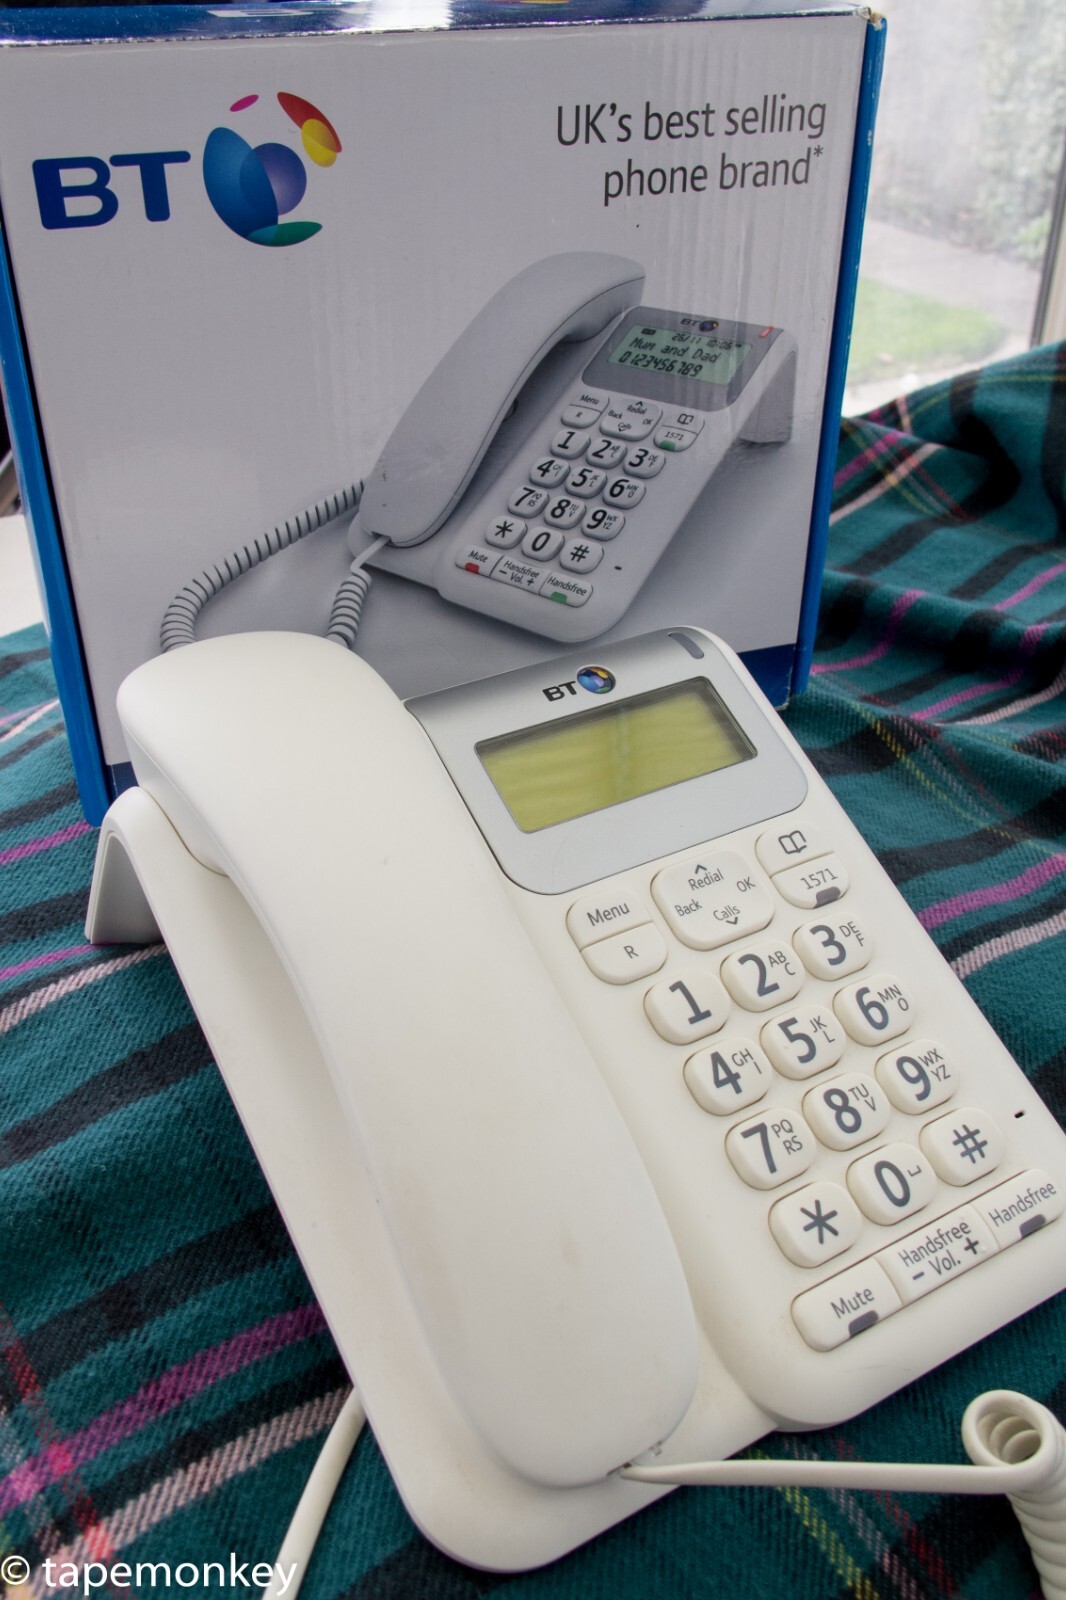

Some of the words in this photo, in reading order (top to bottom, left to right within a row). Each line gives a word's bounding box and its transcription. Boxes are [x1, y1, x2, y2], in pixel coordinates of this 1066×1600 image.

[557, 103, 632, 146] UK’s
[644, 101, 716, 140] best
[724, 93, 827, 139] selling
[32, 150, 192, 230] BT
[604, 158, 708, 207] phone
[629, 337, 656, 351] Mum
[661, 344, 690, 357] and
[692, 348, 722, 363] Dad
[618, 351, 703, 377] 0123456789
[580, 394, 599, 405] Menu
[608, 409, 624, 419] Back
[627, 405, 647, 415] Redial
[618, 422, 632, 430] Calls
[664, 431, 684, 441] 1571
[557, 431, 576, 450] 1
[592, 439, 612, 459] 2
[628, 448, 649, 467] 3
[537, 459, 555, 478] 4
[571, 468, 593, 488] 5
[514, 487, 535, 507] 7
[609, 479, 629, 498] 6
[550, 499, 571, 519] 8
[586, 509, 607, 529] 9
[603, 522, 613, 530] YZ
[531, 532, 551, 552] 0
[468, 550, 488, 563] Mute
[570, 544, 590, 562] #
[504, 560, 540, 579] Handsfree
[510, 572, 523, 584] Vol.
[547, 576, 587, 596] Handsfree
[542, 681, 577, 702] BT
[688, 868, 724, 892] Redial
[736, 876, 756, 893] OK
[801, 868, 838, 891] 1571
[587, 902, 631, 927] Menu
[674, 899, 703, 918] Back
[713, 903, 741, 922] Calls
[838, 921, 860, 938] DE
[809, 924, 847, 966] 3
[855, 933, 866, 947] F
[623, 944, 640, 959] R
[767, 950, 788, 968] AB
[738, 953, 780, 997] 2
[784, 962, 797, 976] C
[669, 980, 712, 1025] 1
[877, 984, 903, 1003] MN
[854, 986, 889, 1031] 6
[809, 1015, 828, 1034] JK
[778, 1016, 817, 1064] 5
[822, 1029, 835, 1043] L
[731, 1047, 754, 1067] GH
[918, 1048, 944, 1068] WX
[710, 1051, 742, 1095] 4
[895, 1055, 931, 1101] 9
[931, 1064, 951, 1083] YZ
[847, 1083, 870, 1101] TU
[822, 1087, 862, 1134] 8
[864, 1097, 877, 1112] V
[771, 1118, 795, 1139] PQ
[740, 1122, 778, 1174] 7
[783, 1135, 803, 1156] RS
[952, 1123, 988, 1164] #
[873, 1160, 911, 1208] 0
[988, 1181, 1057, 1229] Handsfree
[897, 1220, 972, 1268] Handsfree
[931, 1251, 962, 1277] Vol.
[830, 1286, 875, 1319] Mute
